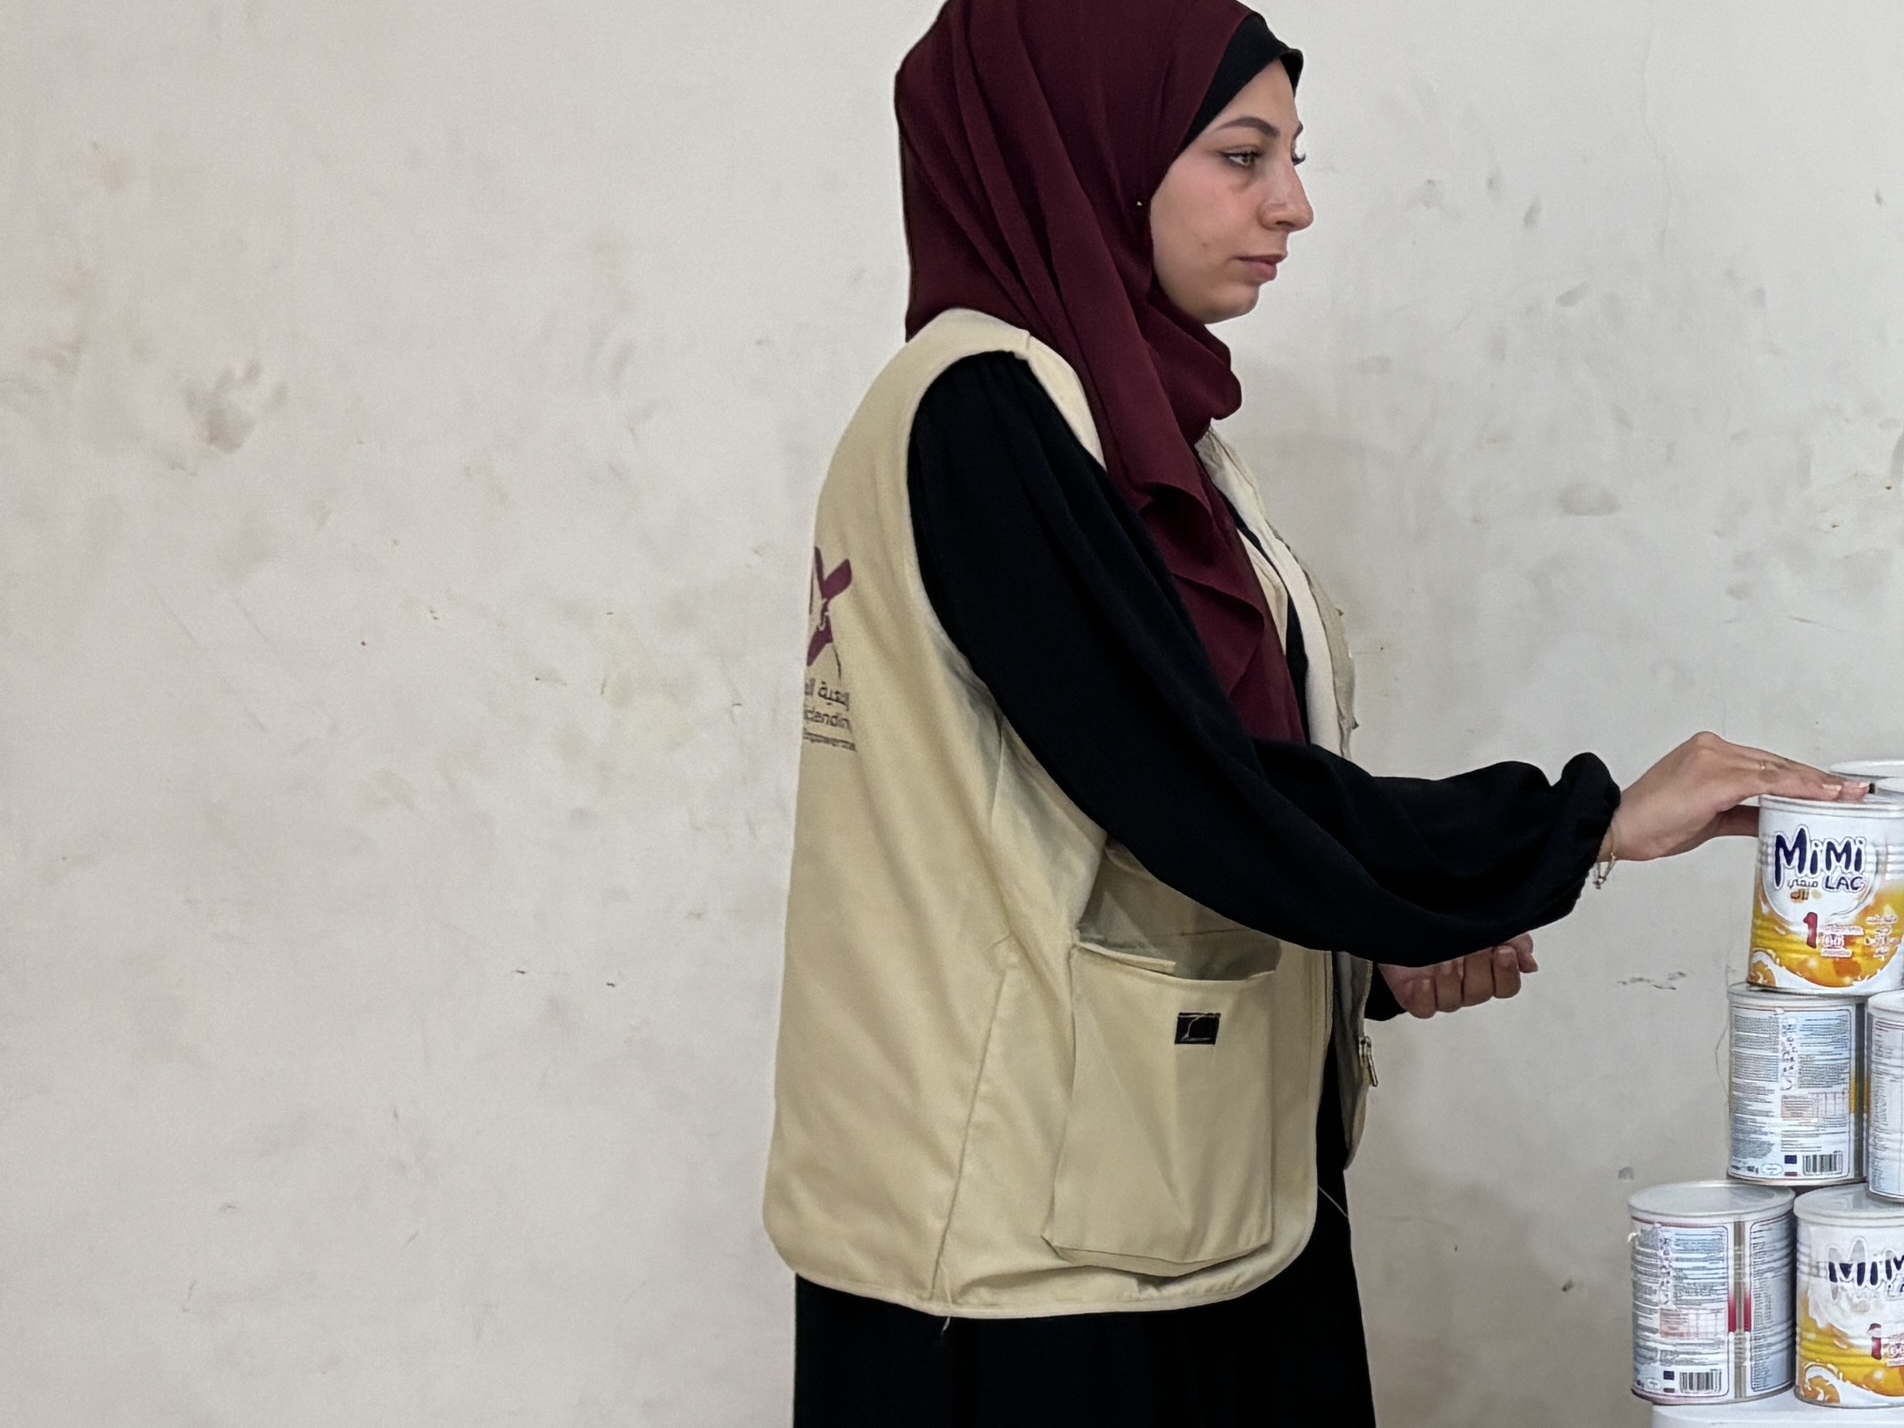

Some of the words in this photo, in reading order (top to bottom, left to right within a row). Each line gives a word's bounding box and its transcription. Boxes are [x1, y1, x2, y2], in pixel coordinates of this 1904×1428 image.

[1824, 875, 1863, 891] LAC
[1803, 912, 1818, 949] 1
[1868, 1323, 1882, 1360] 1
